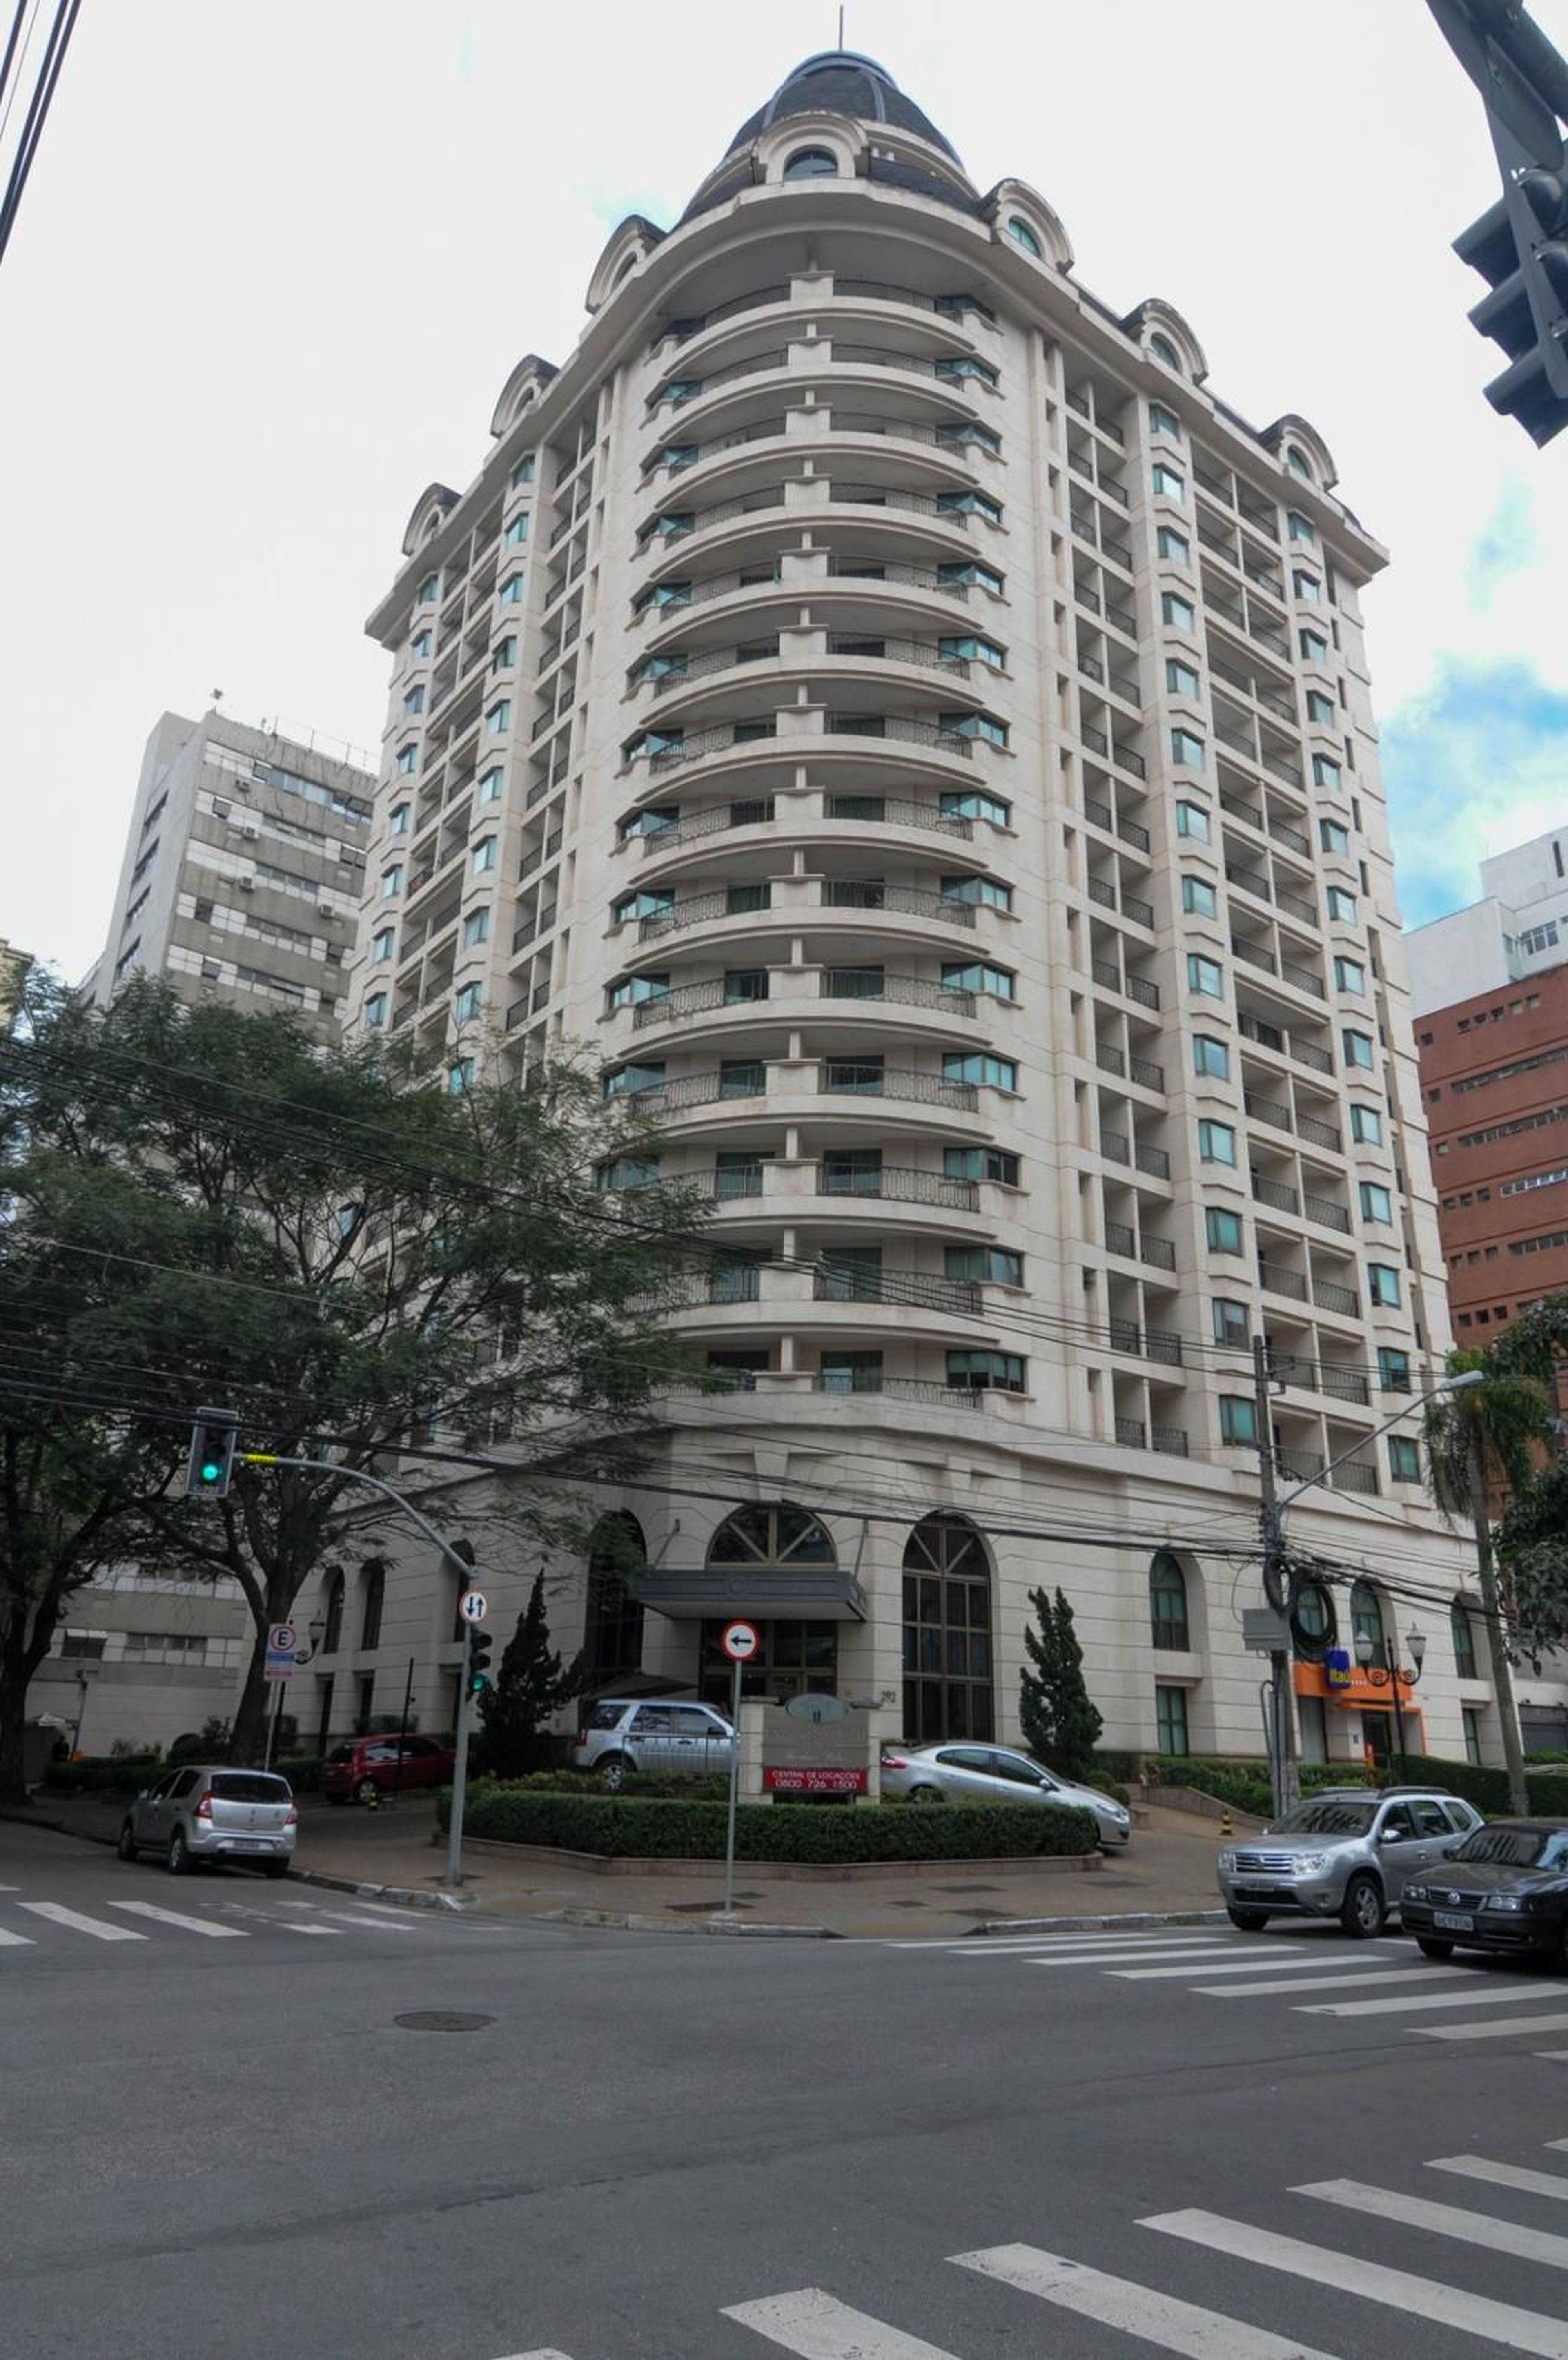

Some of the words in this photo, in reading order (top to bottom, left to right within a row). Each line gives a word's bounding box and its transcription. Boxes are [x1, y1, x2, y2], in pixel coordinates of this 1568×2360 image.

[278, 1631, 287, 1646] E
[771, 1770, 805, 1779] CENTRAL
[776, 1779, 803, 1788] 0800
[808, 1779, 827, 1789] 726
